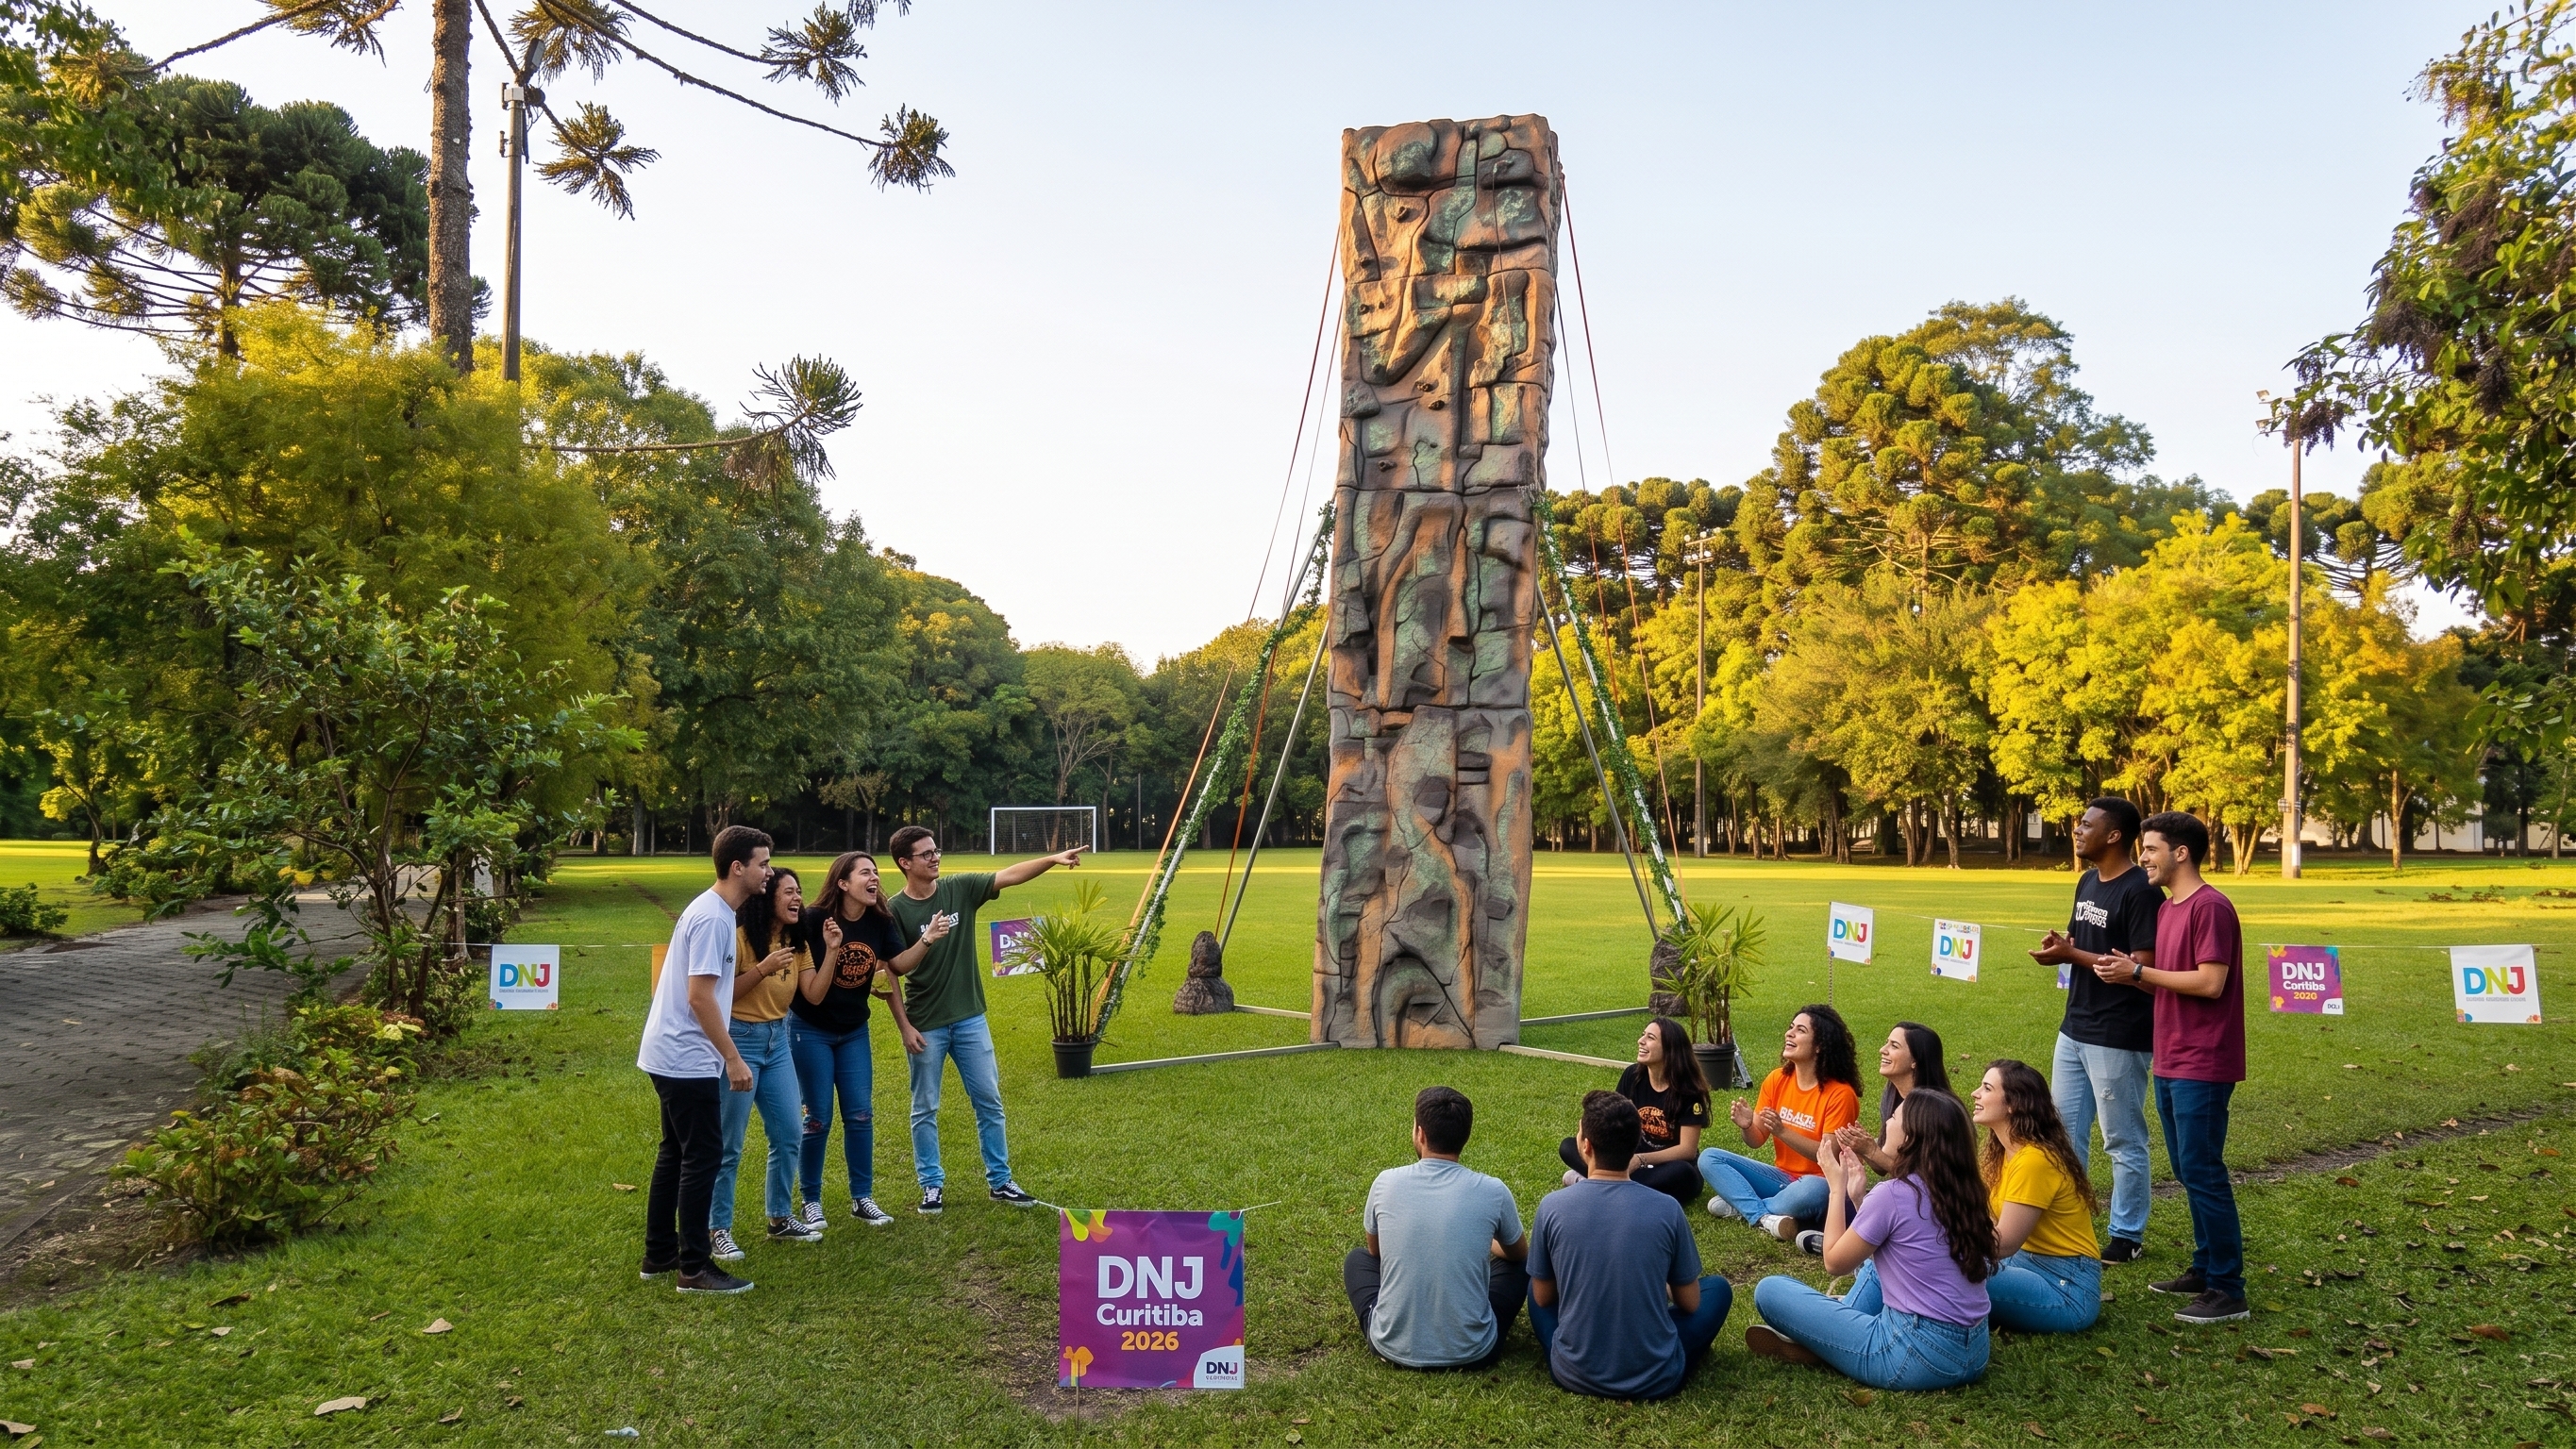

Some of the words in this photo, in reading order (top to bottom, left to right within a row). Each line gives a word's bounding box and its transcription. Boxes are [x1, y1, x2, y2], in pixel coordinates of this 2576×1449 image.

[1832, 918, 1867, 943] DNJ
[1939, 935, 1973, 960] DNJ
[499, 963, 551, 988] DNJ
[2282, 962, 2325, 980] DNJ
[2463, 966, 2526, 995] DNJ
[1097, 1256, 1204, 1299] DNJ
[1096, 1303, 1203, 1326] Curitiba
[1121, 1331, 1179, 1351] 2026
[1206, 1361, 1238, 1374] DNJ
